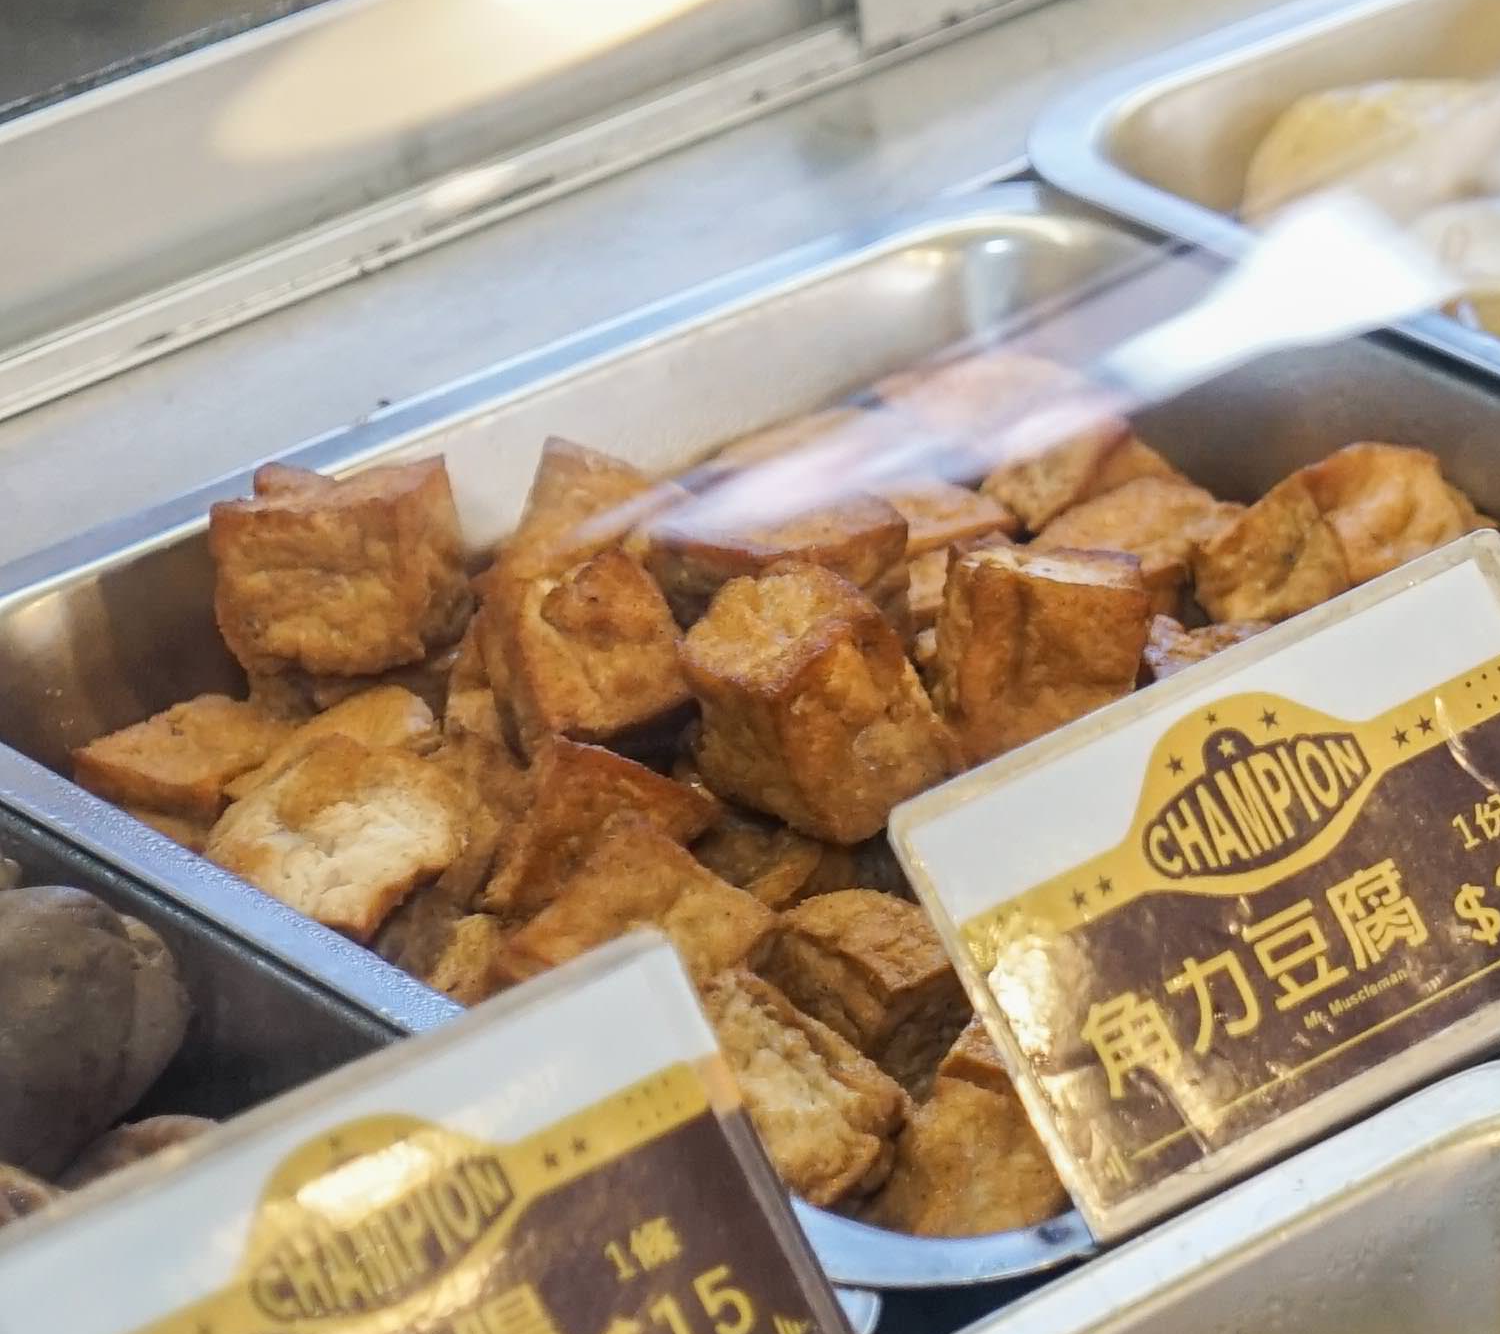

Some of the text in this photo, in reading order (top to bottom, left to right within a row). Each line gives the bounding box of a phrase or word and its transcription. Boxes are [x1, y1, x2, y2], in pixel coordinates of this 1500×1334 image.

[1149, 737, 1366, 875] CHAMPION
[1081, 858, 1428, 1100] 角力豆腐
[1328, 967, 1408, 1017] Muscleman
[250, 1153, 514, 1322] CHAMPION
